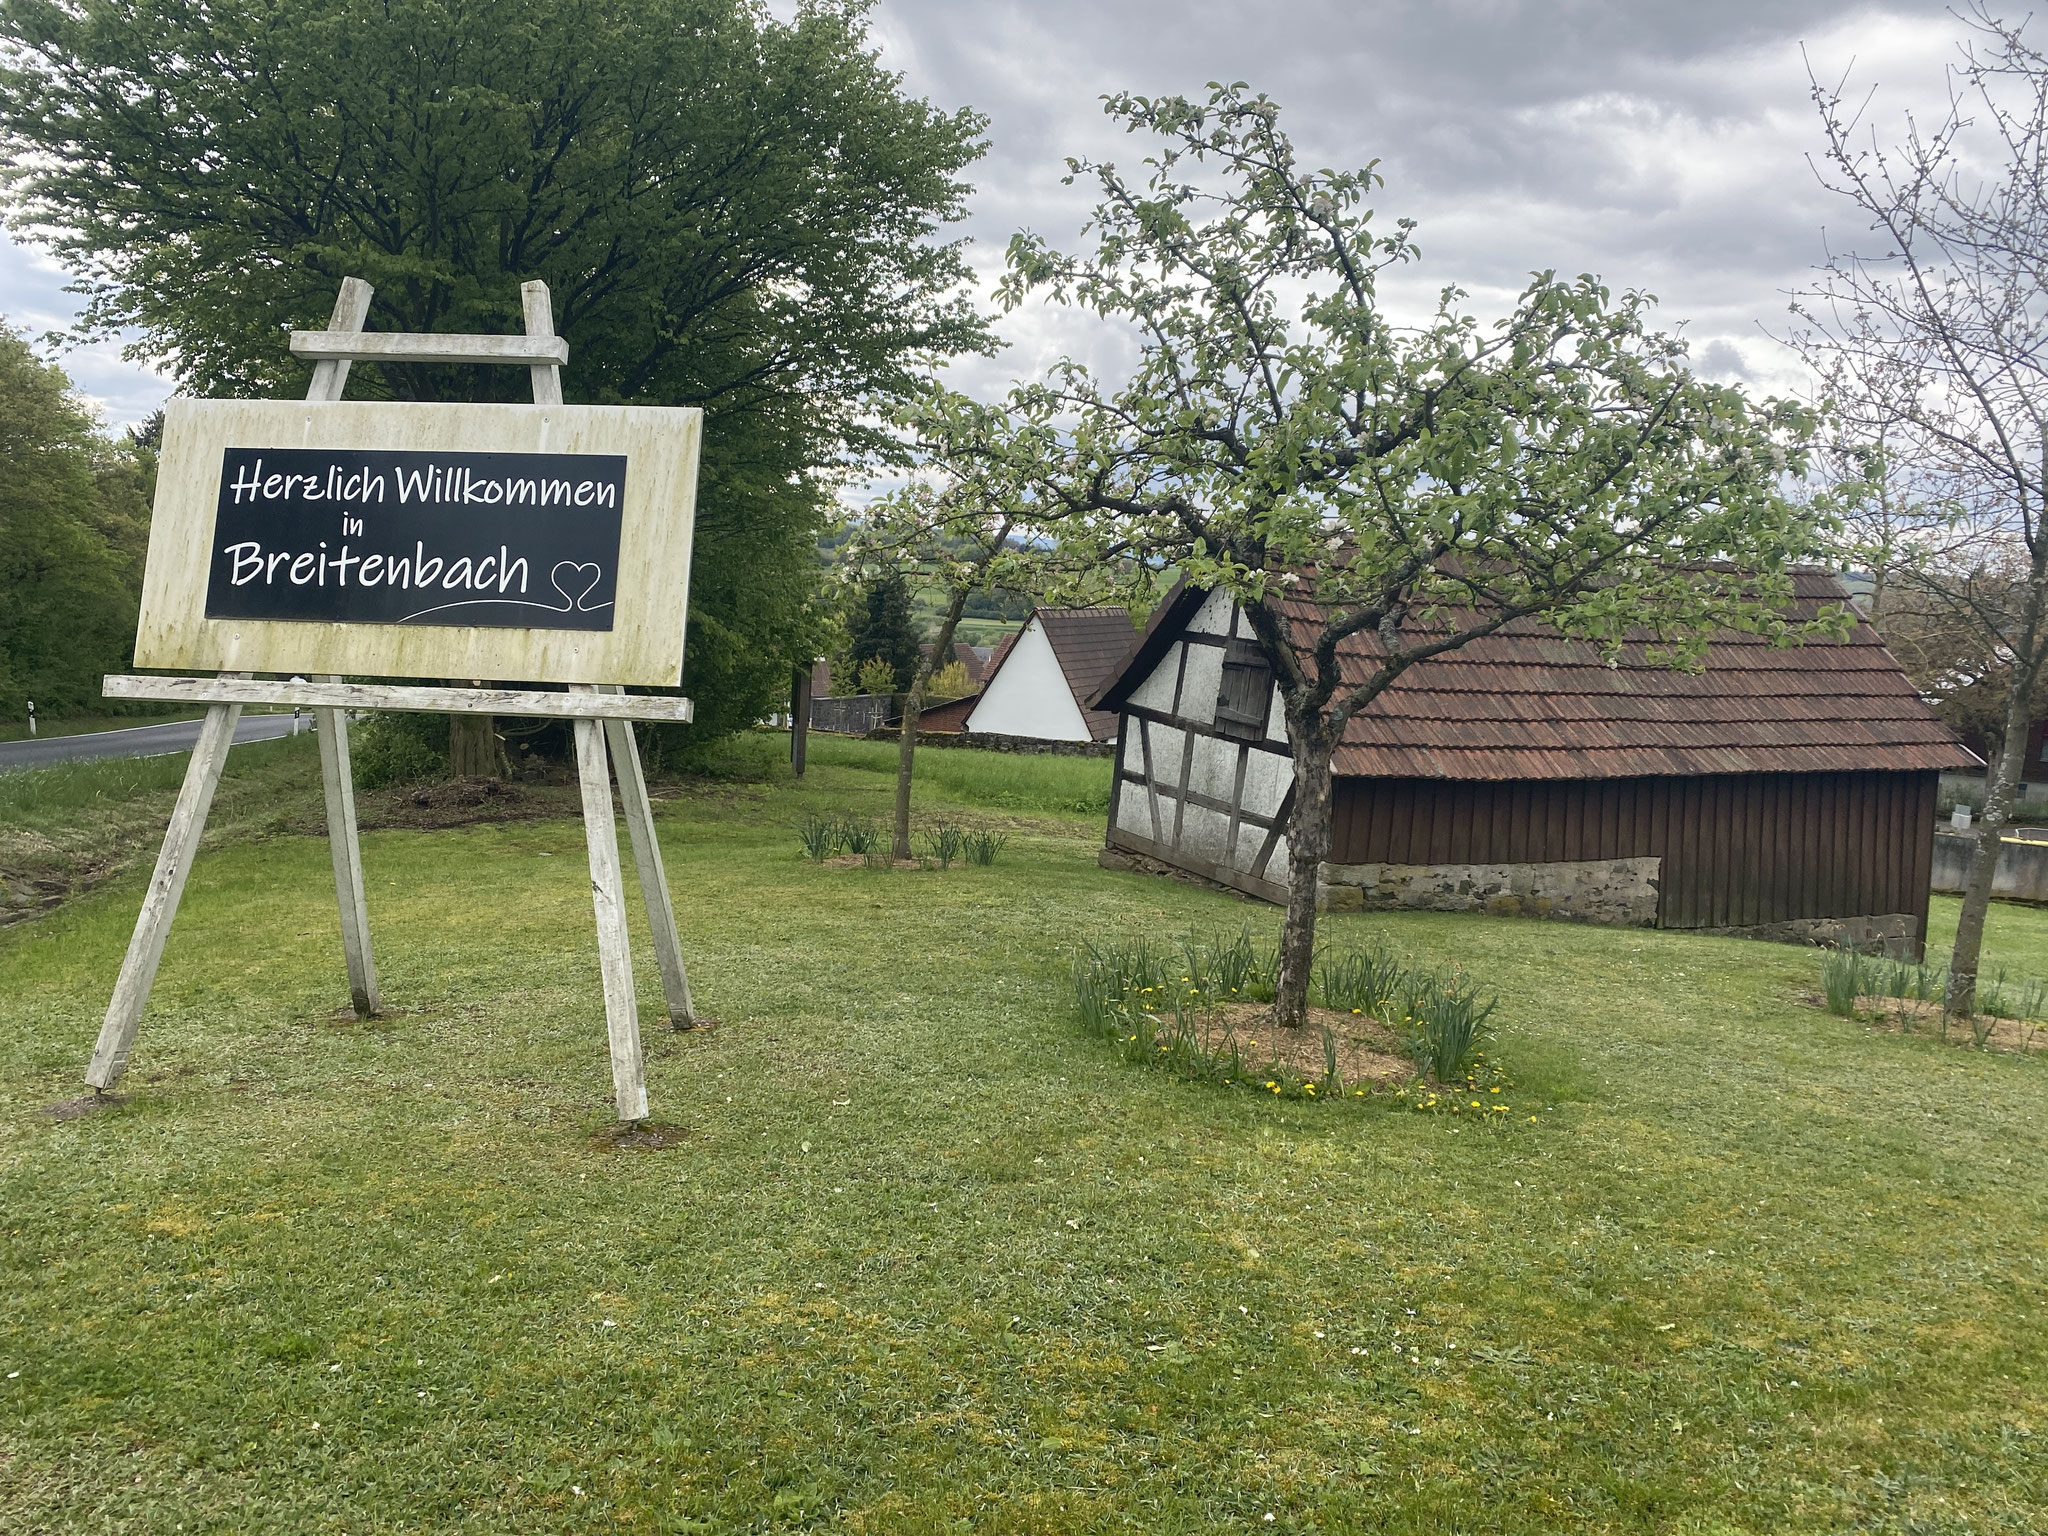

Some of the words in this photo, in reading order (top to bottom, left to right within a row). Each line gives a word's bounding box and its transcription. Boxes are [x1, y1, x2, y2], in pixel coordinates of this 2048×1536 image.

[229, 458, 385, 504] Herzlich
[394, 463, 616, 509] Willkommen
[342, 510, 364, 538] in
[223, 540, 530, 594] Breitenbach
